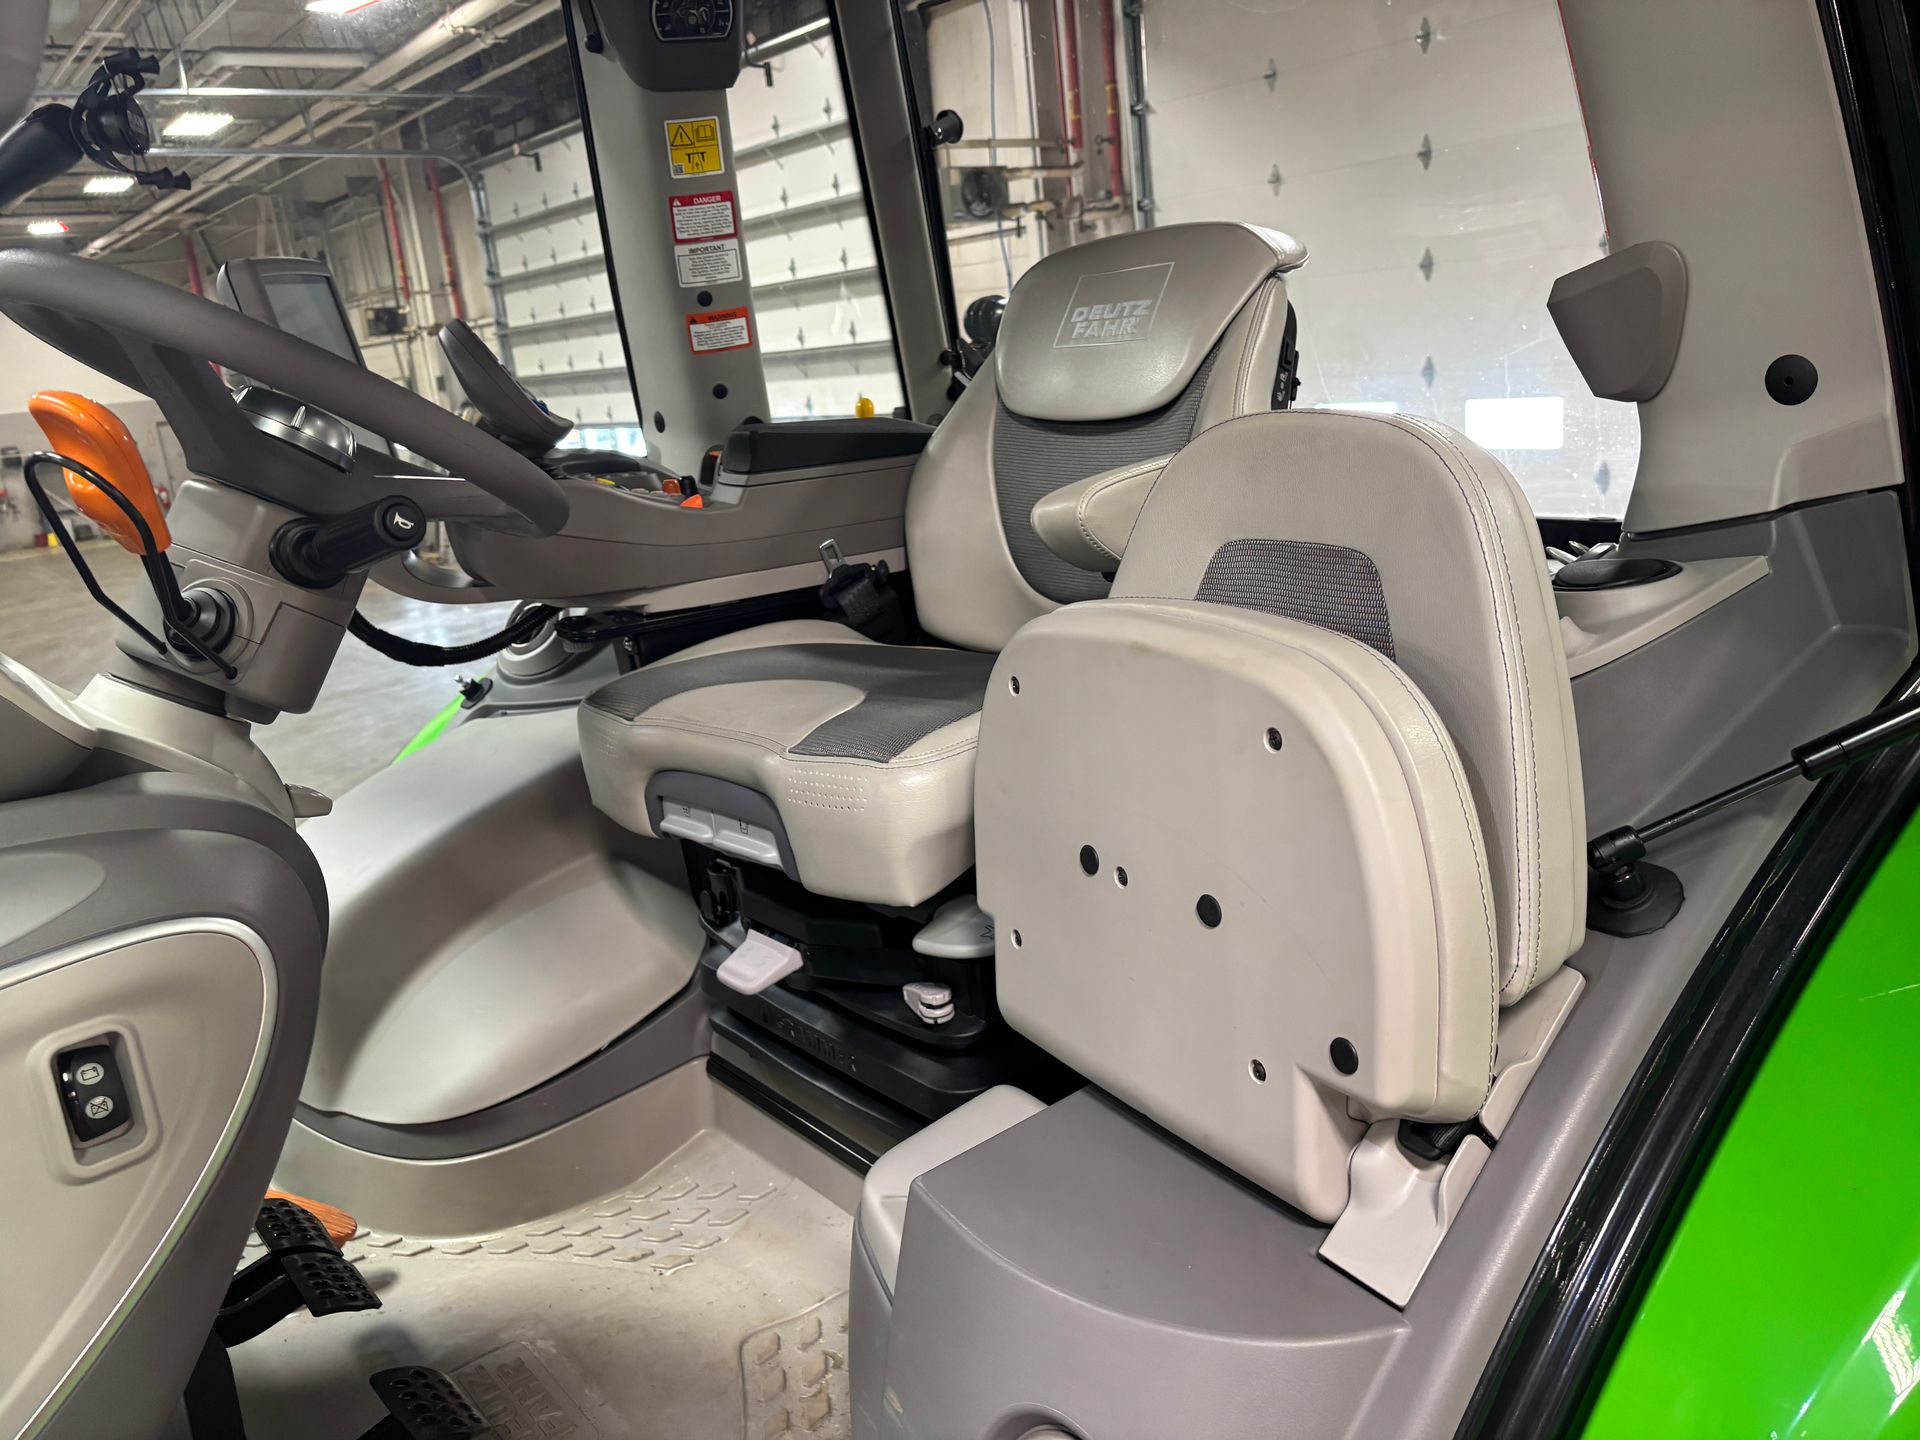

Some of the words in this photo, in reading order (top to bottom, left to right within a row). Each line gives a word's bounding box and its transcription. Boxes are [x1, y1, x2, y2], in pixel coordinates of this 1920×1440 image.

[692, 195, 722, 205] DANGER
[688, 244, 725, 254] IMPORTANT
[1070, 300, 1152, 322] DEUTZ
[1071, 317, 1139, 339] FAHR
